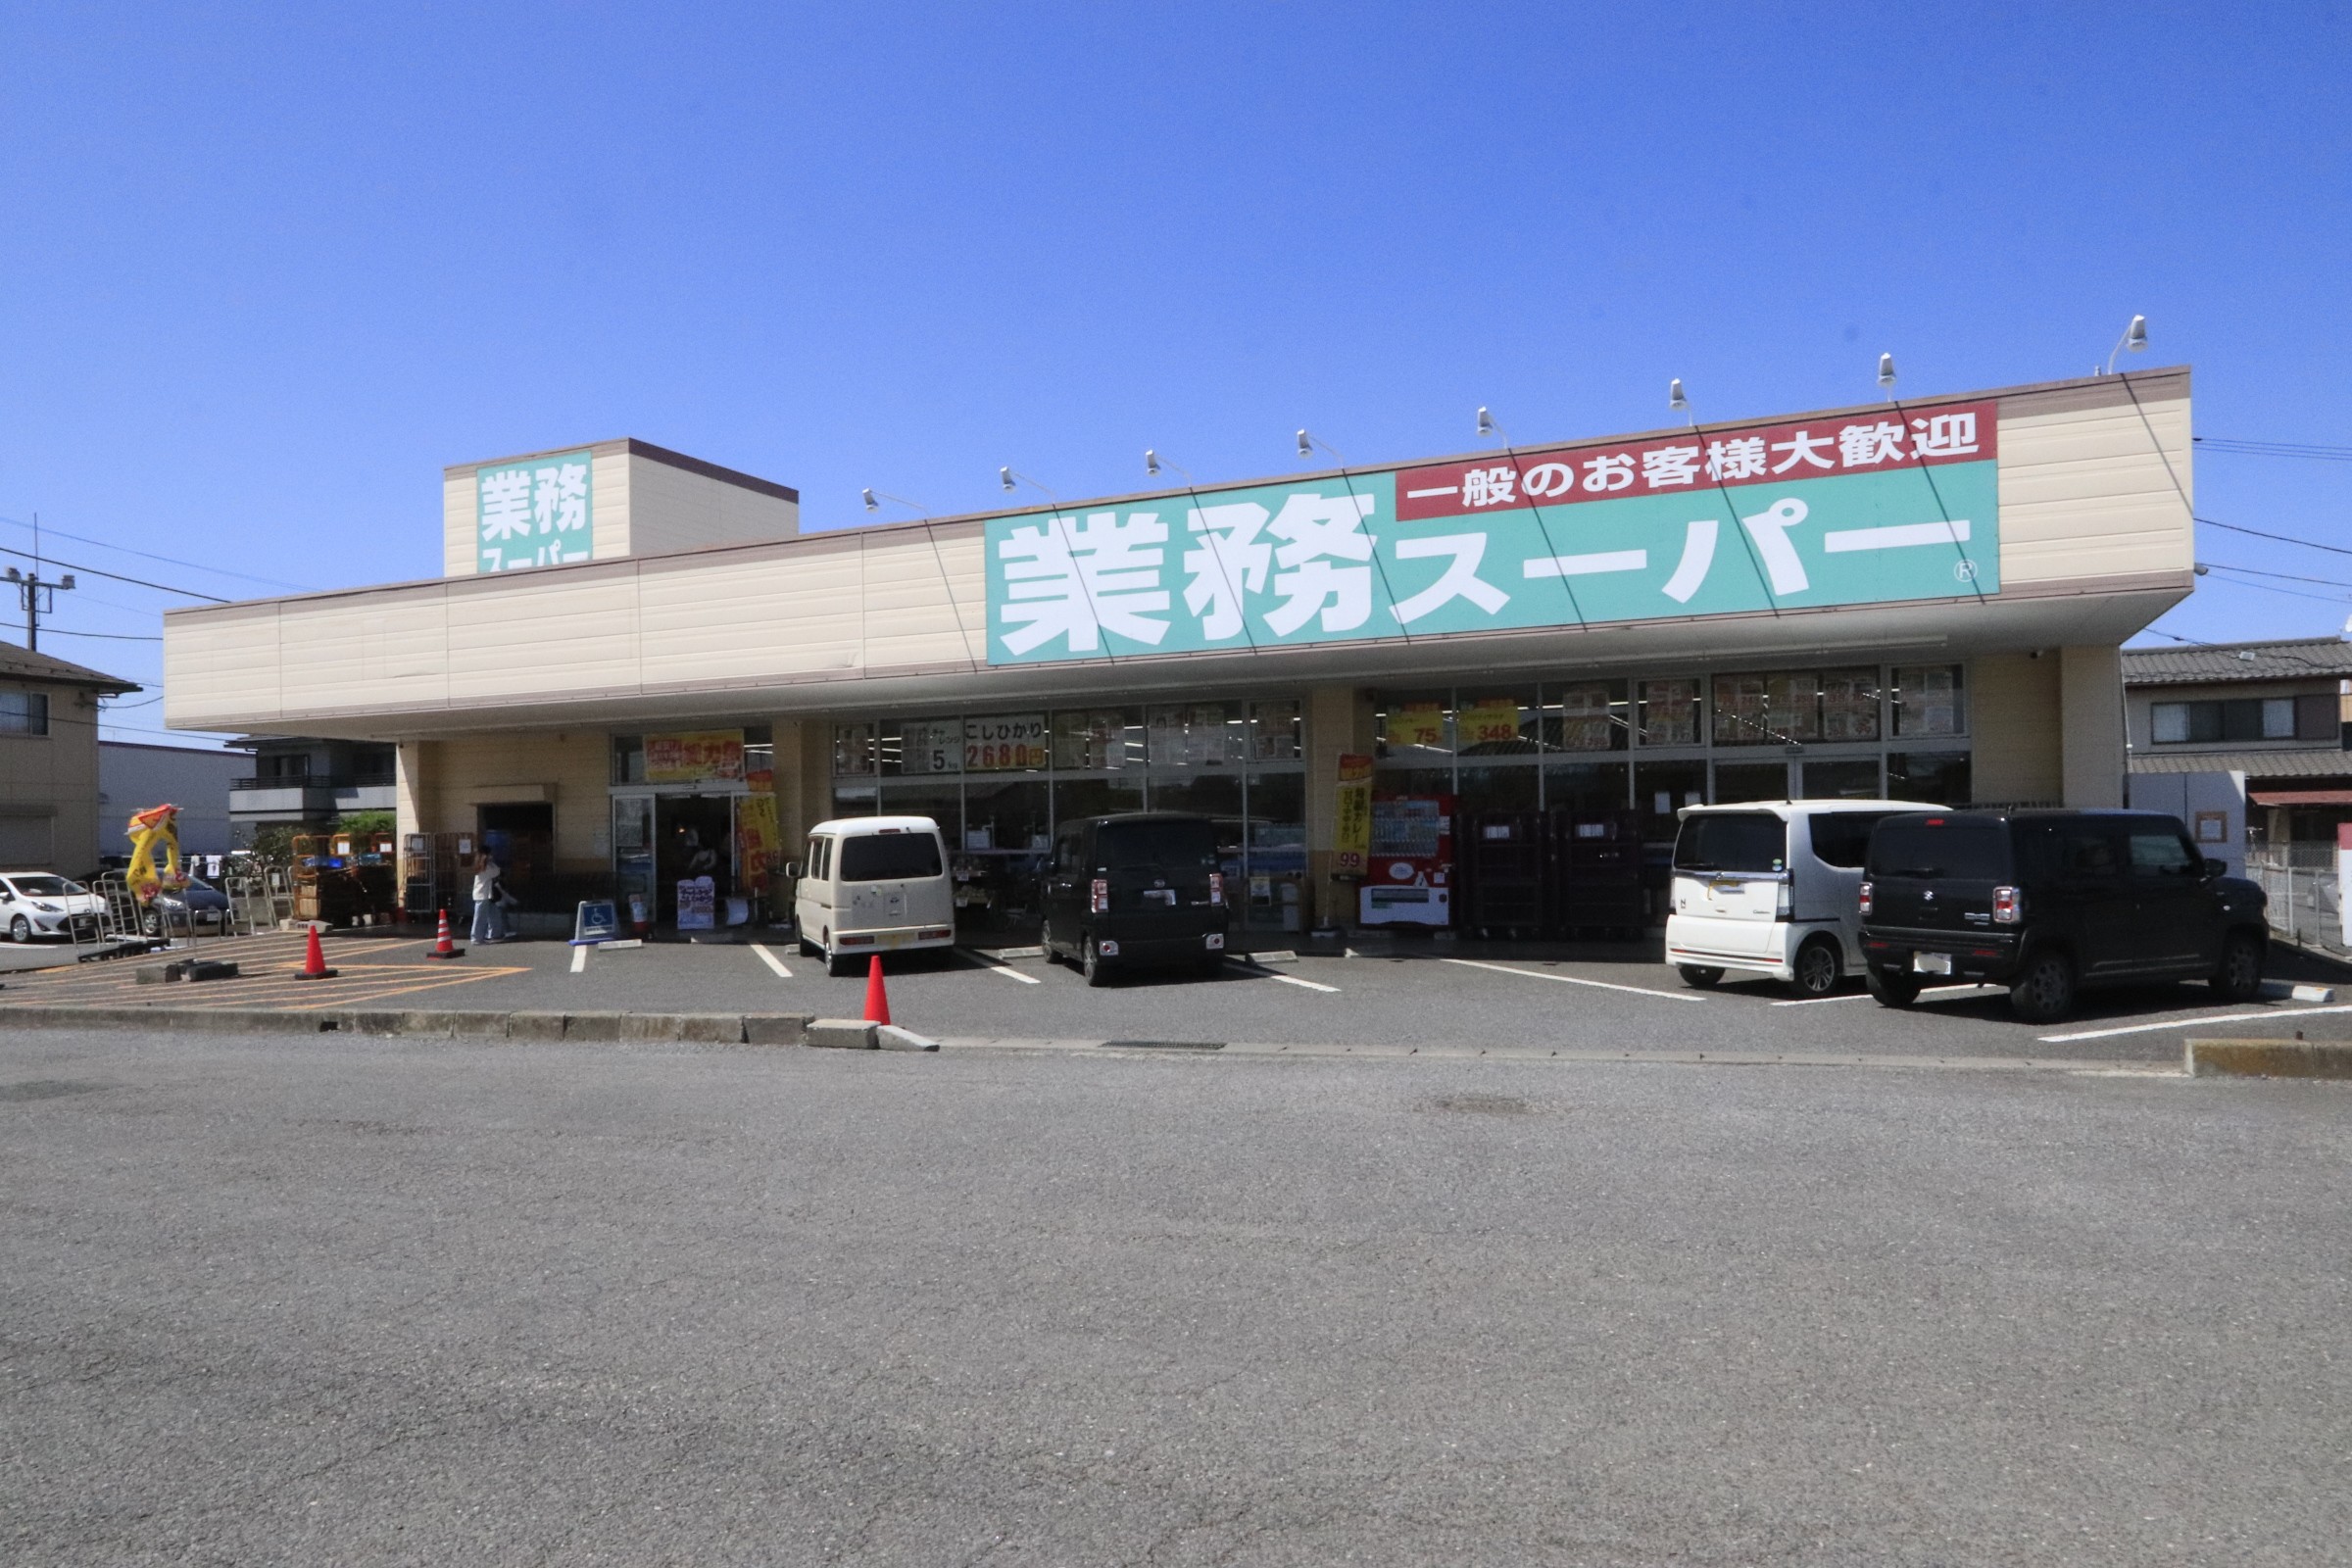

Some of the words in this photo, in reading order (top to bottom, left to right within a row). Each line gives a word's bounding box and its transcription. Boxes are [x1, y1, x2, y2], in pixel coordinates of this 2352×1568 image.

[1407, 412, 1980, 508] 一般のお客様大歓迎
[481, 463, 588, 542] 業務
[999, 493, 1972, 657] 業務スーパー
[965, 721, 1043, 741] こしひかり
[1413, 726, 1438, 744] 75
[1477, 724, 1512, 741] 348
[966, 743, 1044, 768] 2680円
[1340, 852, 1361, 868] 99
